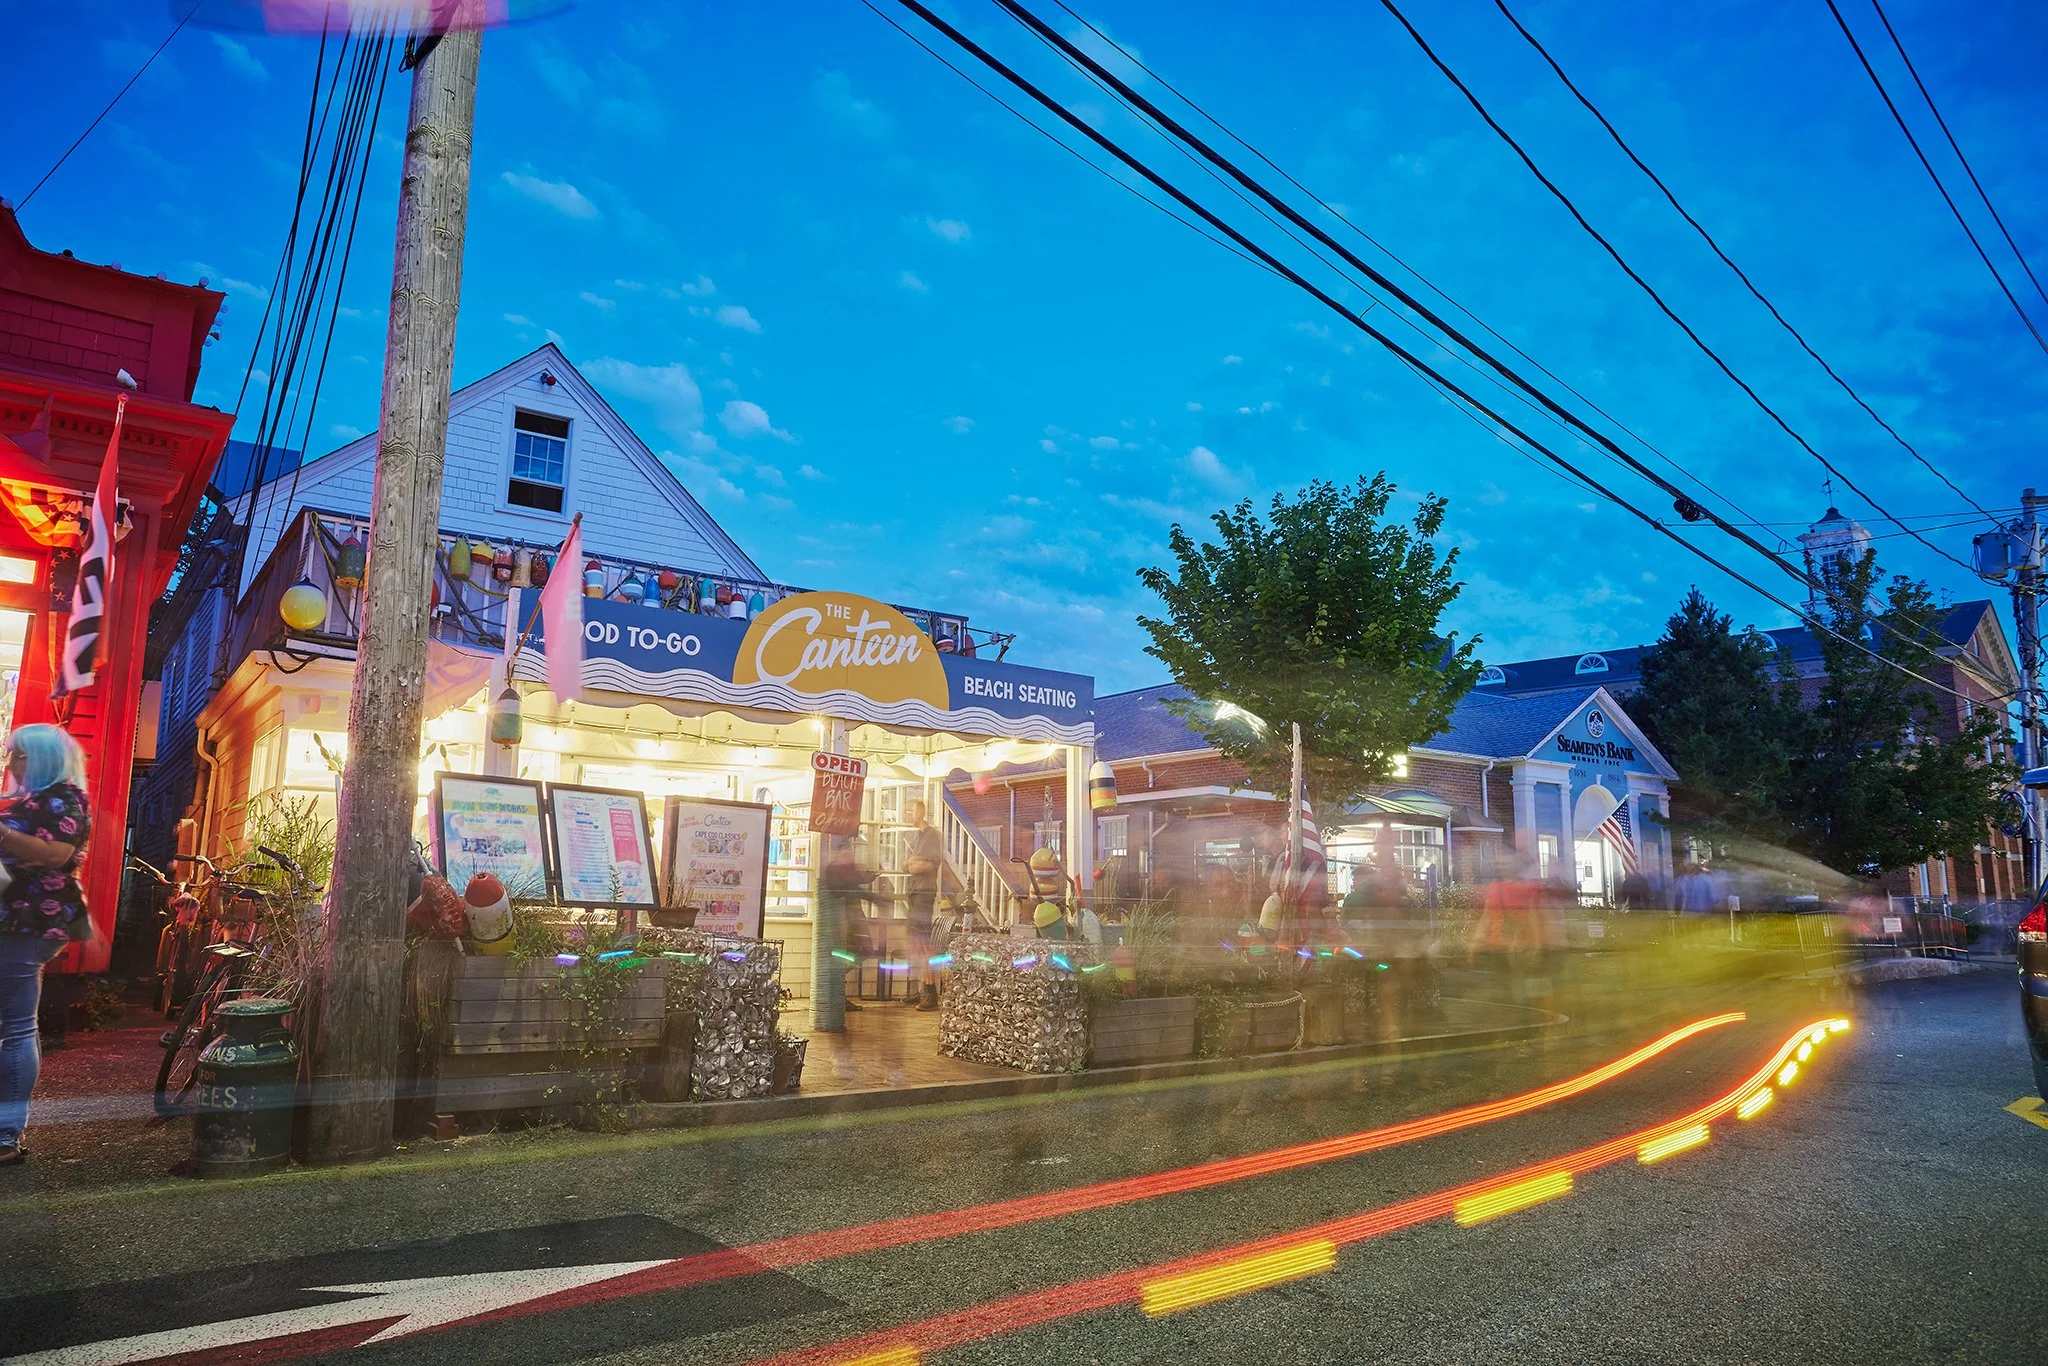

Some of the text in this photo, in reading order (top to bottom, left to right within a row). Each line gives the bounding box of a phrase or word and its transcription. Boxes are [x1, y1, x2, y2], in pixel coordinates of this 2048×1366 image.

[825, 603, 851, 620] THE
[579, 619, 701, 656] OD TO-GO
[755, 607, 922, 684] Canteen
[964, 676, 1077, 709] BEACH SEATING
[1557, 734, 1636, 761] SEAMEN'S BANK
[815, 753, 862, 775] OPEN
[1571, 755, 1600, 764] MEMBER
[822, 771, 858, 791] BEACH
[825, 789, 852, 812] BAR
[703, 814, 732, 827] Canteen
[718, 832, 741, 840] CLASSICS
[200, 1069, 217, 1080] FOR
